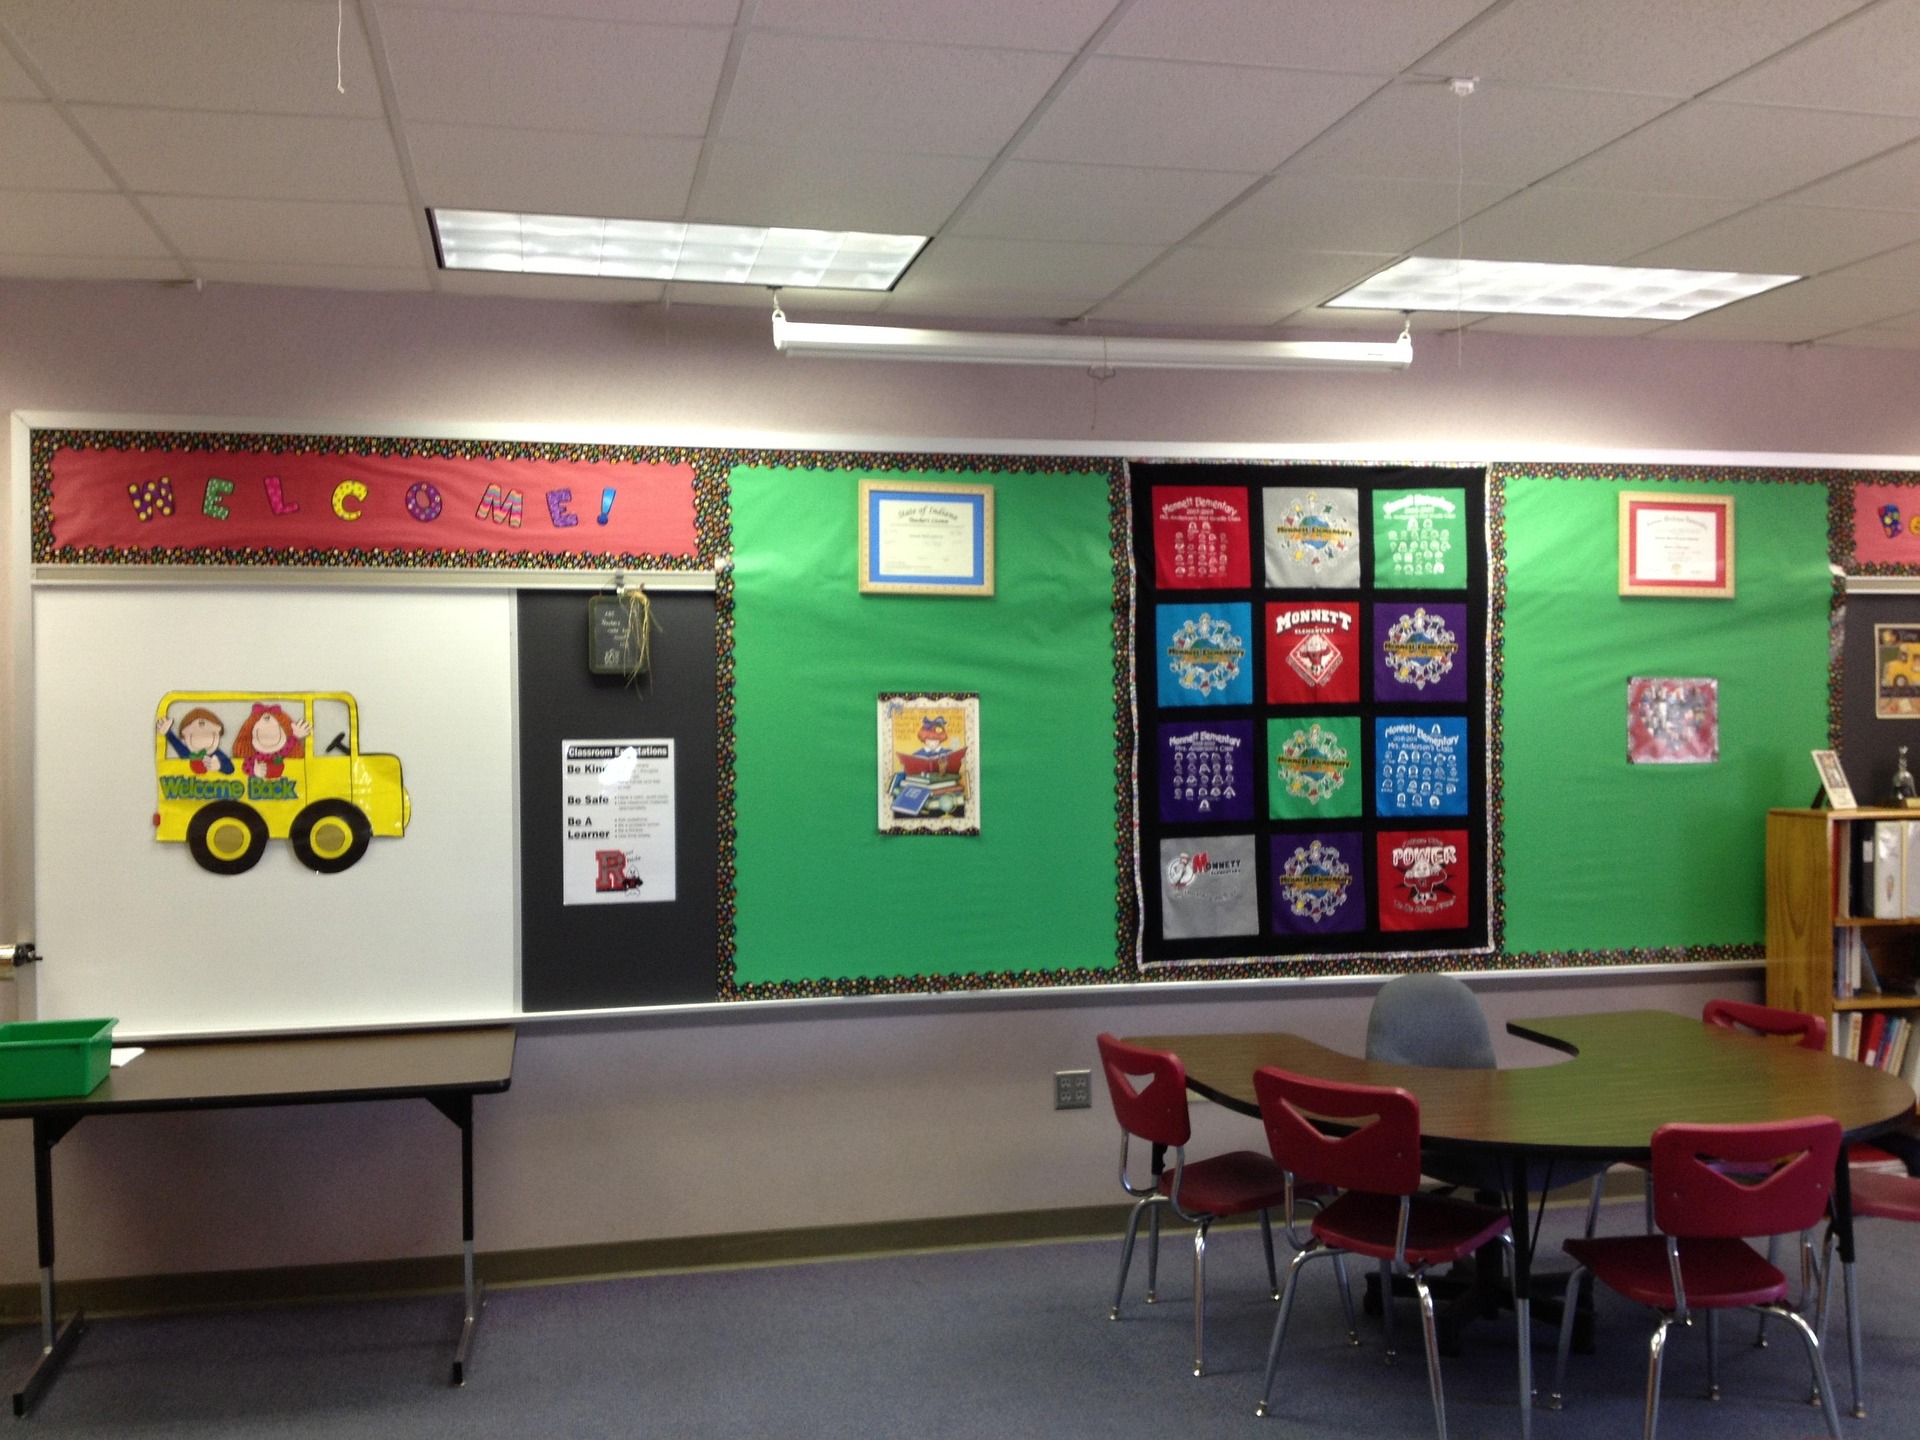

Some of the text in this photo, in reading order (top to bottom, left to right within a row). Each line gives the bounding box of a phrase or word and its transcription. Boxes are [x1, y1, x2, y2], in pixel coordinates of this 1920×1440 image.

[1276, 609, 1352, 634] MONNETT
[569, 747, 614, 758] Classroom
[567, 765, 581, 774] Be
[159, 776, 299, 801] Welcome Back
[567, 795, 582, 805] Be
[585, 795, 610, 805] Safe
[567, 817, 593, 827] Be A
[567, 830, 610, 840] Learner
[1392, 845, 1457, 867] POWER
